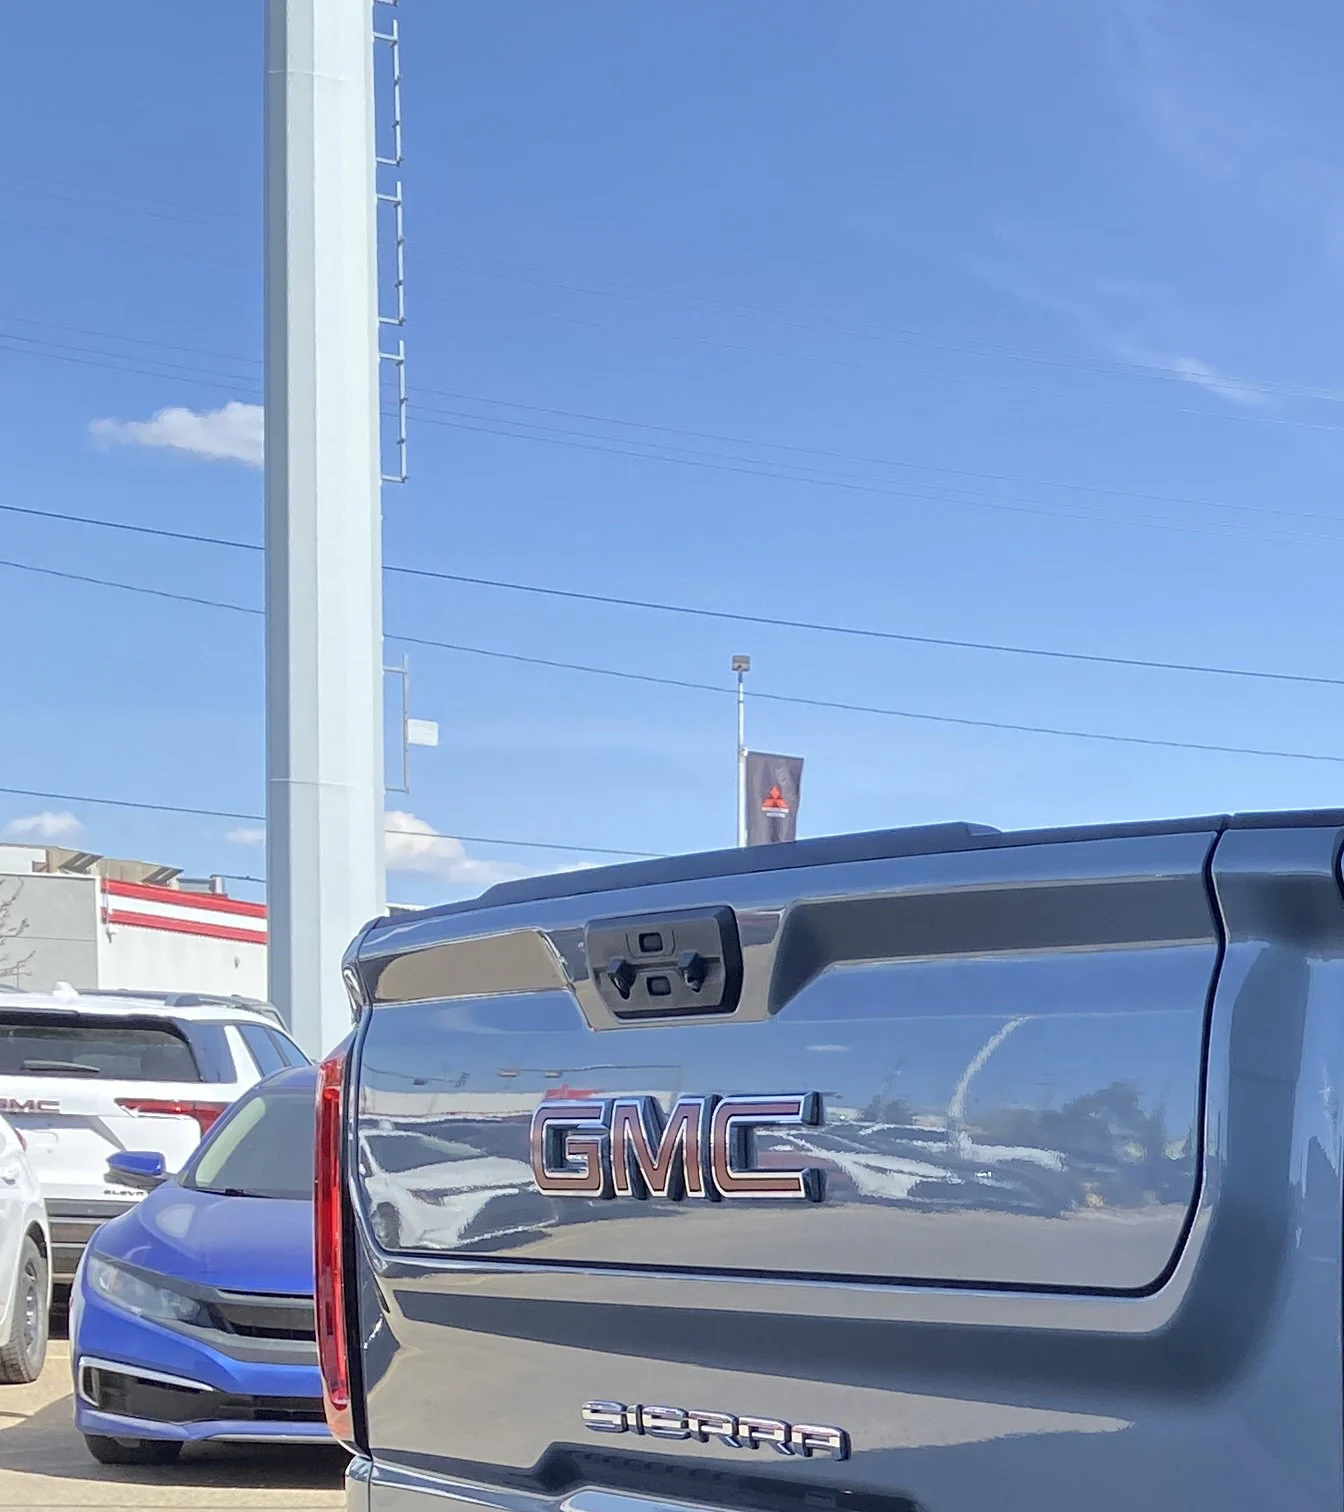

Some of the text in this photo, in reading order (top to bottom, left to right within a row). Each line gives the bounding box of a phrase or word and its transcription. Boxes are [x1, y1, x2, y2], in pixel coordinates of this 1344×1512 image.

[0, 1098, 60, 1113] MC
[530, 1091, 826, 1200] GMC
[580, 1400, 852, 1461] SIERRA
